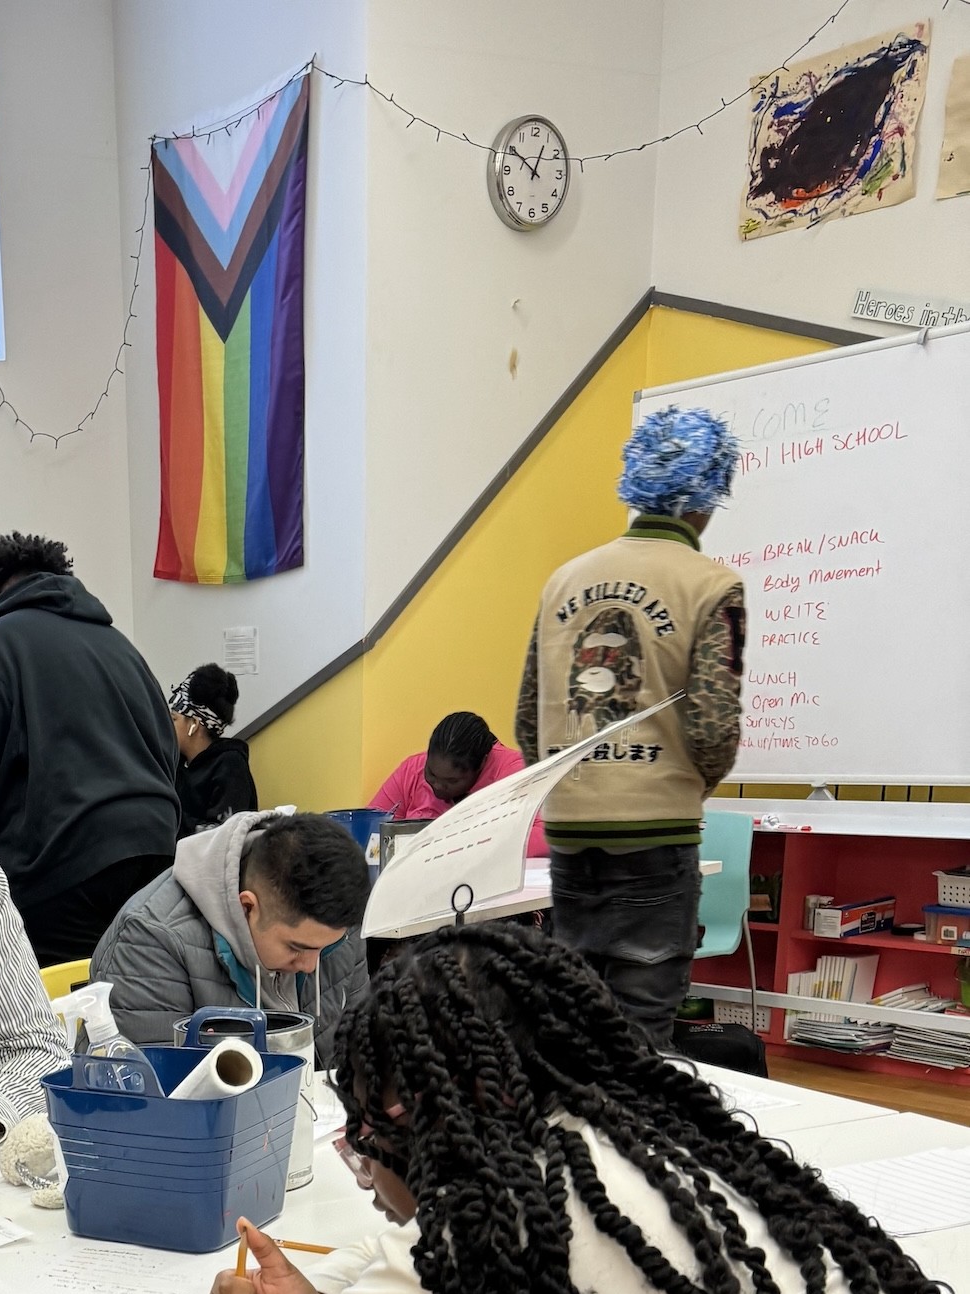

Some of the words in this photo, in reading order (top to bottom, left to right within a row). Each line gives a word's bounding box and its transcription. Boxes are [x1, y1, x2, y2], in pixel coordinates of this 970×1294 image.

[531, 127, 540, 137] 12
[553, 149, 560, 159] 2
[504, 165, 510, 175] 9
[556, 170, 562, 180] 3
[507, 186, 514, 196] 8
[551, 189, 557, 198] 4
[516, 202, 522, 212] 7
[541, 203, 548, 213] 5
[529, 208, 535, 218] 6
[853, 290, 915, 323] Heroes
[781, 438, 823, 464] HIGH
[832, 421, 908, 451] SCHOOL
[763, 575, 800, 593] Body
[808, 560, 882, 585] Movement
[583, 581, 647, 606] KILLED
[642, 599, 675, 637] APE
[765, 602, 827, 621] WRITE
[762, 631, 820, 648] PRACTICE
[749, 670, 796, 687] LUNCH
[752, 695, 783, 712] Open
